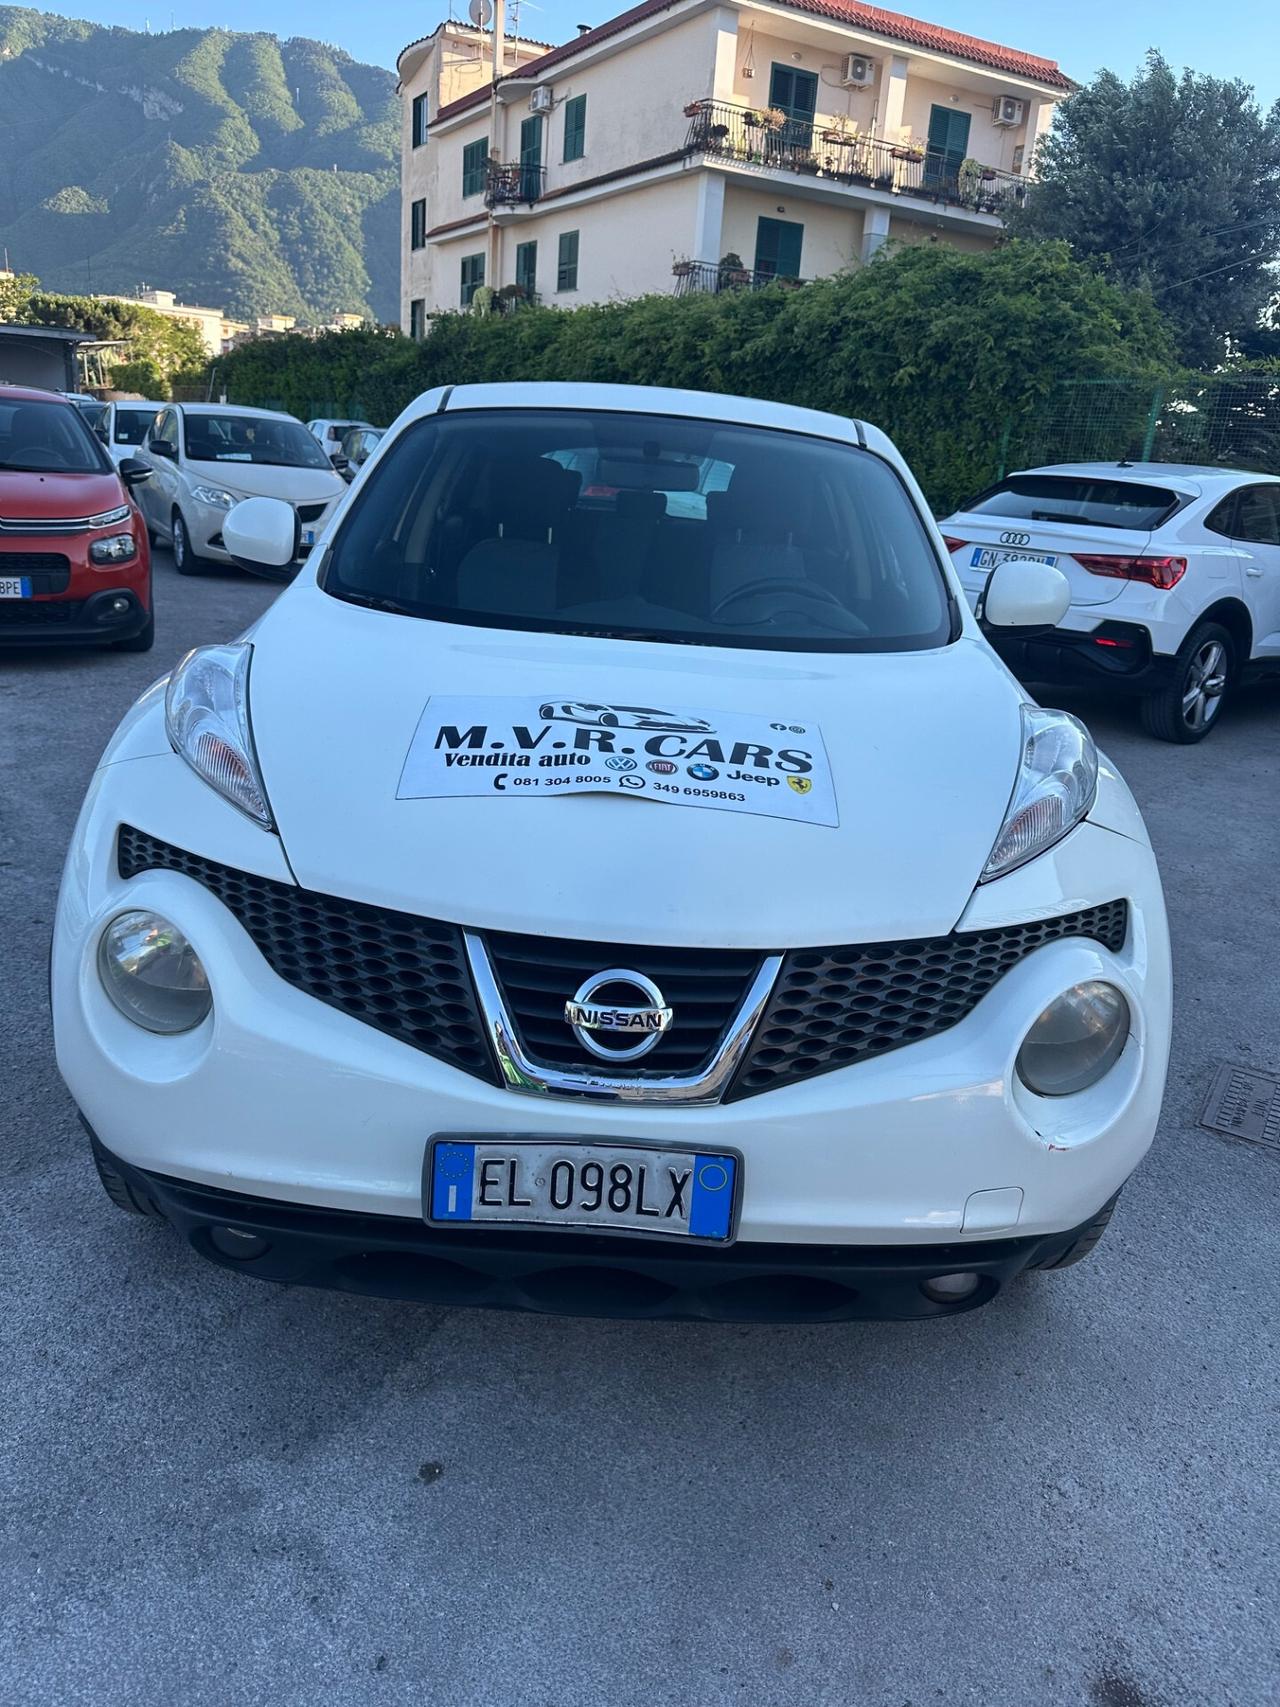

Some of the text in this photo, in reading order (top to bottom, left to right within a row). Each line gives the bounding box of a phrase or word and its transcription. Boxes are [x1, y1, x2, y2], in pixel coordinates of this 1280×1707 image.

[980, 550, 999, 568] GN
[445, 752, 591, 767] Vendita auto
[644, 734, 813, 774] CARS
[513, 775, 611, 786] 081 304 8005
[726, 770, 780, 787] Jeep
[653, 782, 746, 802] 349 6959863
[575, 1007, 663, 1029] NISSAN
[479, 1157, 693, 1220] EL 098LX
